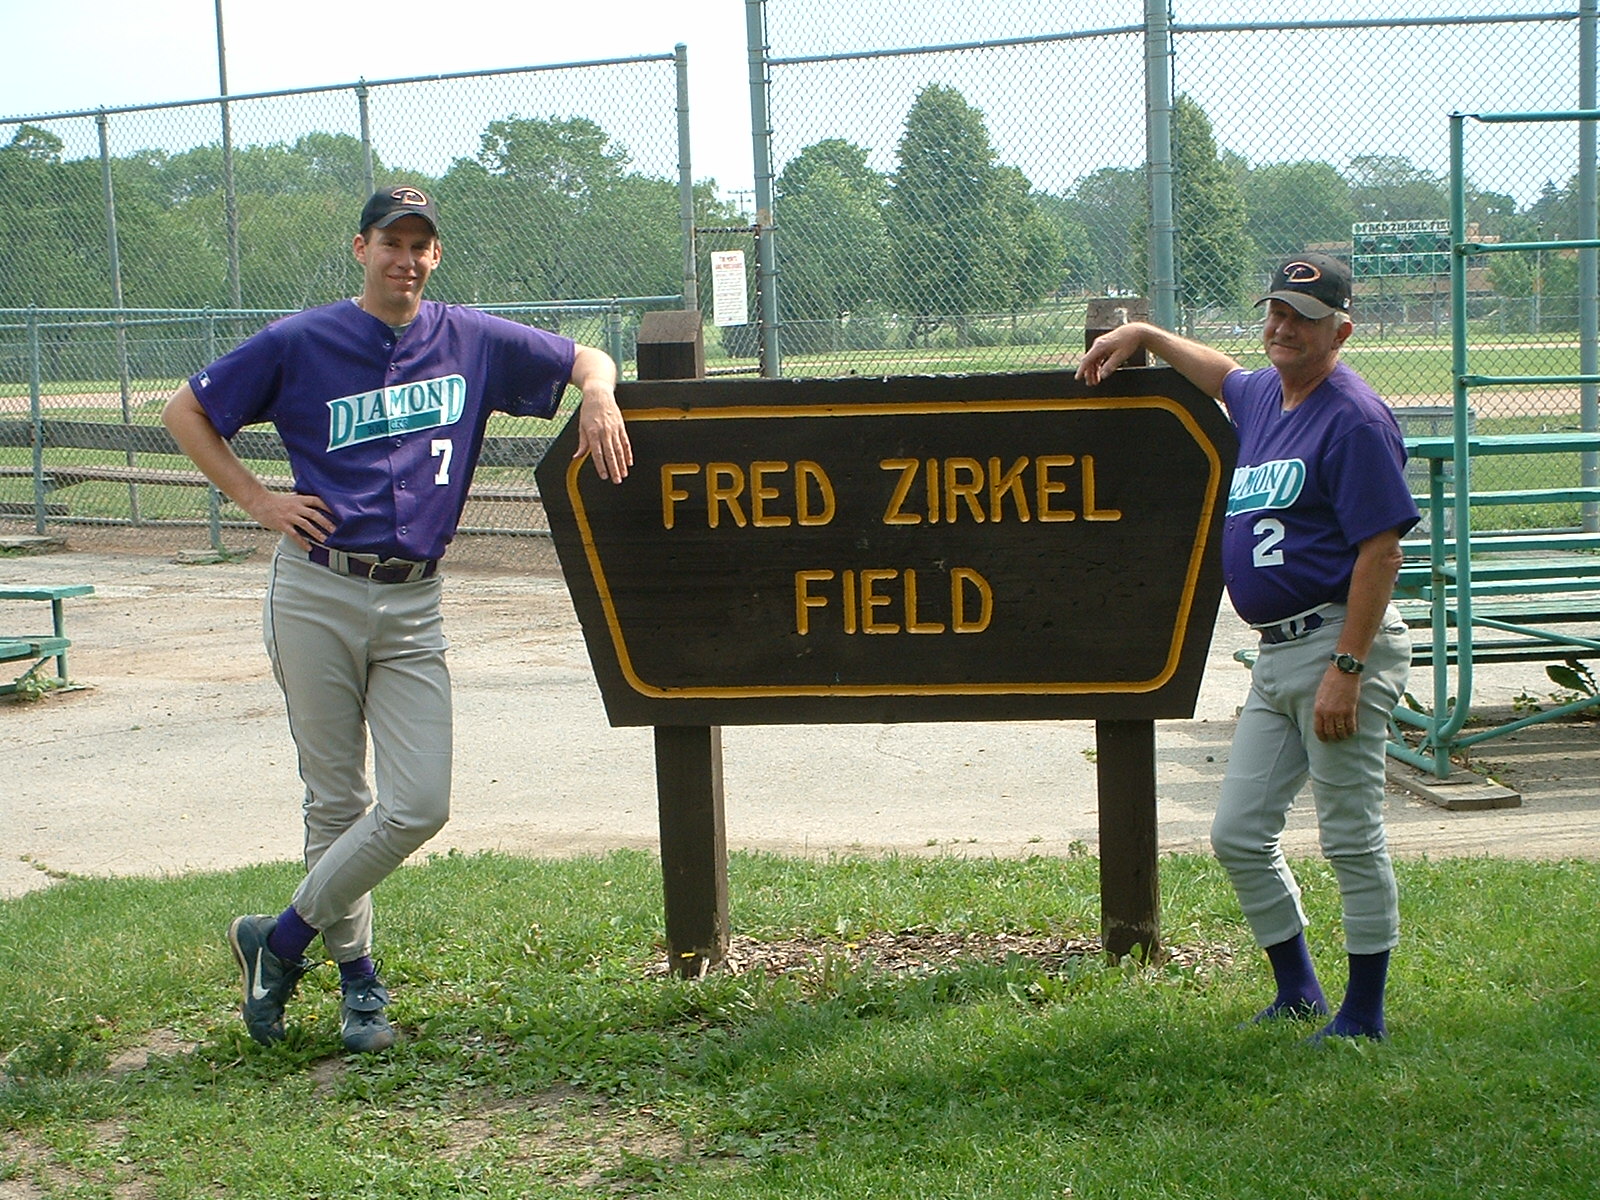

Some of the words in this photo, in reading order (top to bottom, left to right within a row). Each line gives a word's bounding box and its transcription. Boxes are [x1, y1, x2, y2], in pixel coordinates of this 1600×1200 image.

[329, 377, 465, 449] DIAMOND
[431, 439, 453, 485] 7
[661, 461, 836, 530] FRED
[879, 455, 1122, 525] ZIRKEL
[1253, 518, 1285, 567] 2
[795, 567, 993, 635] FIELD
